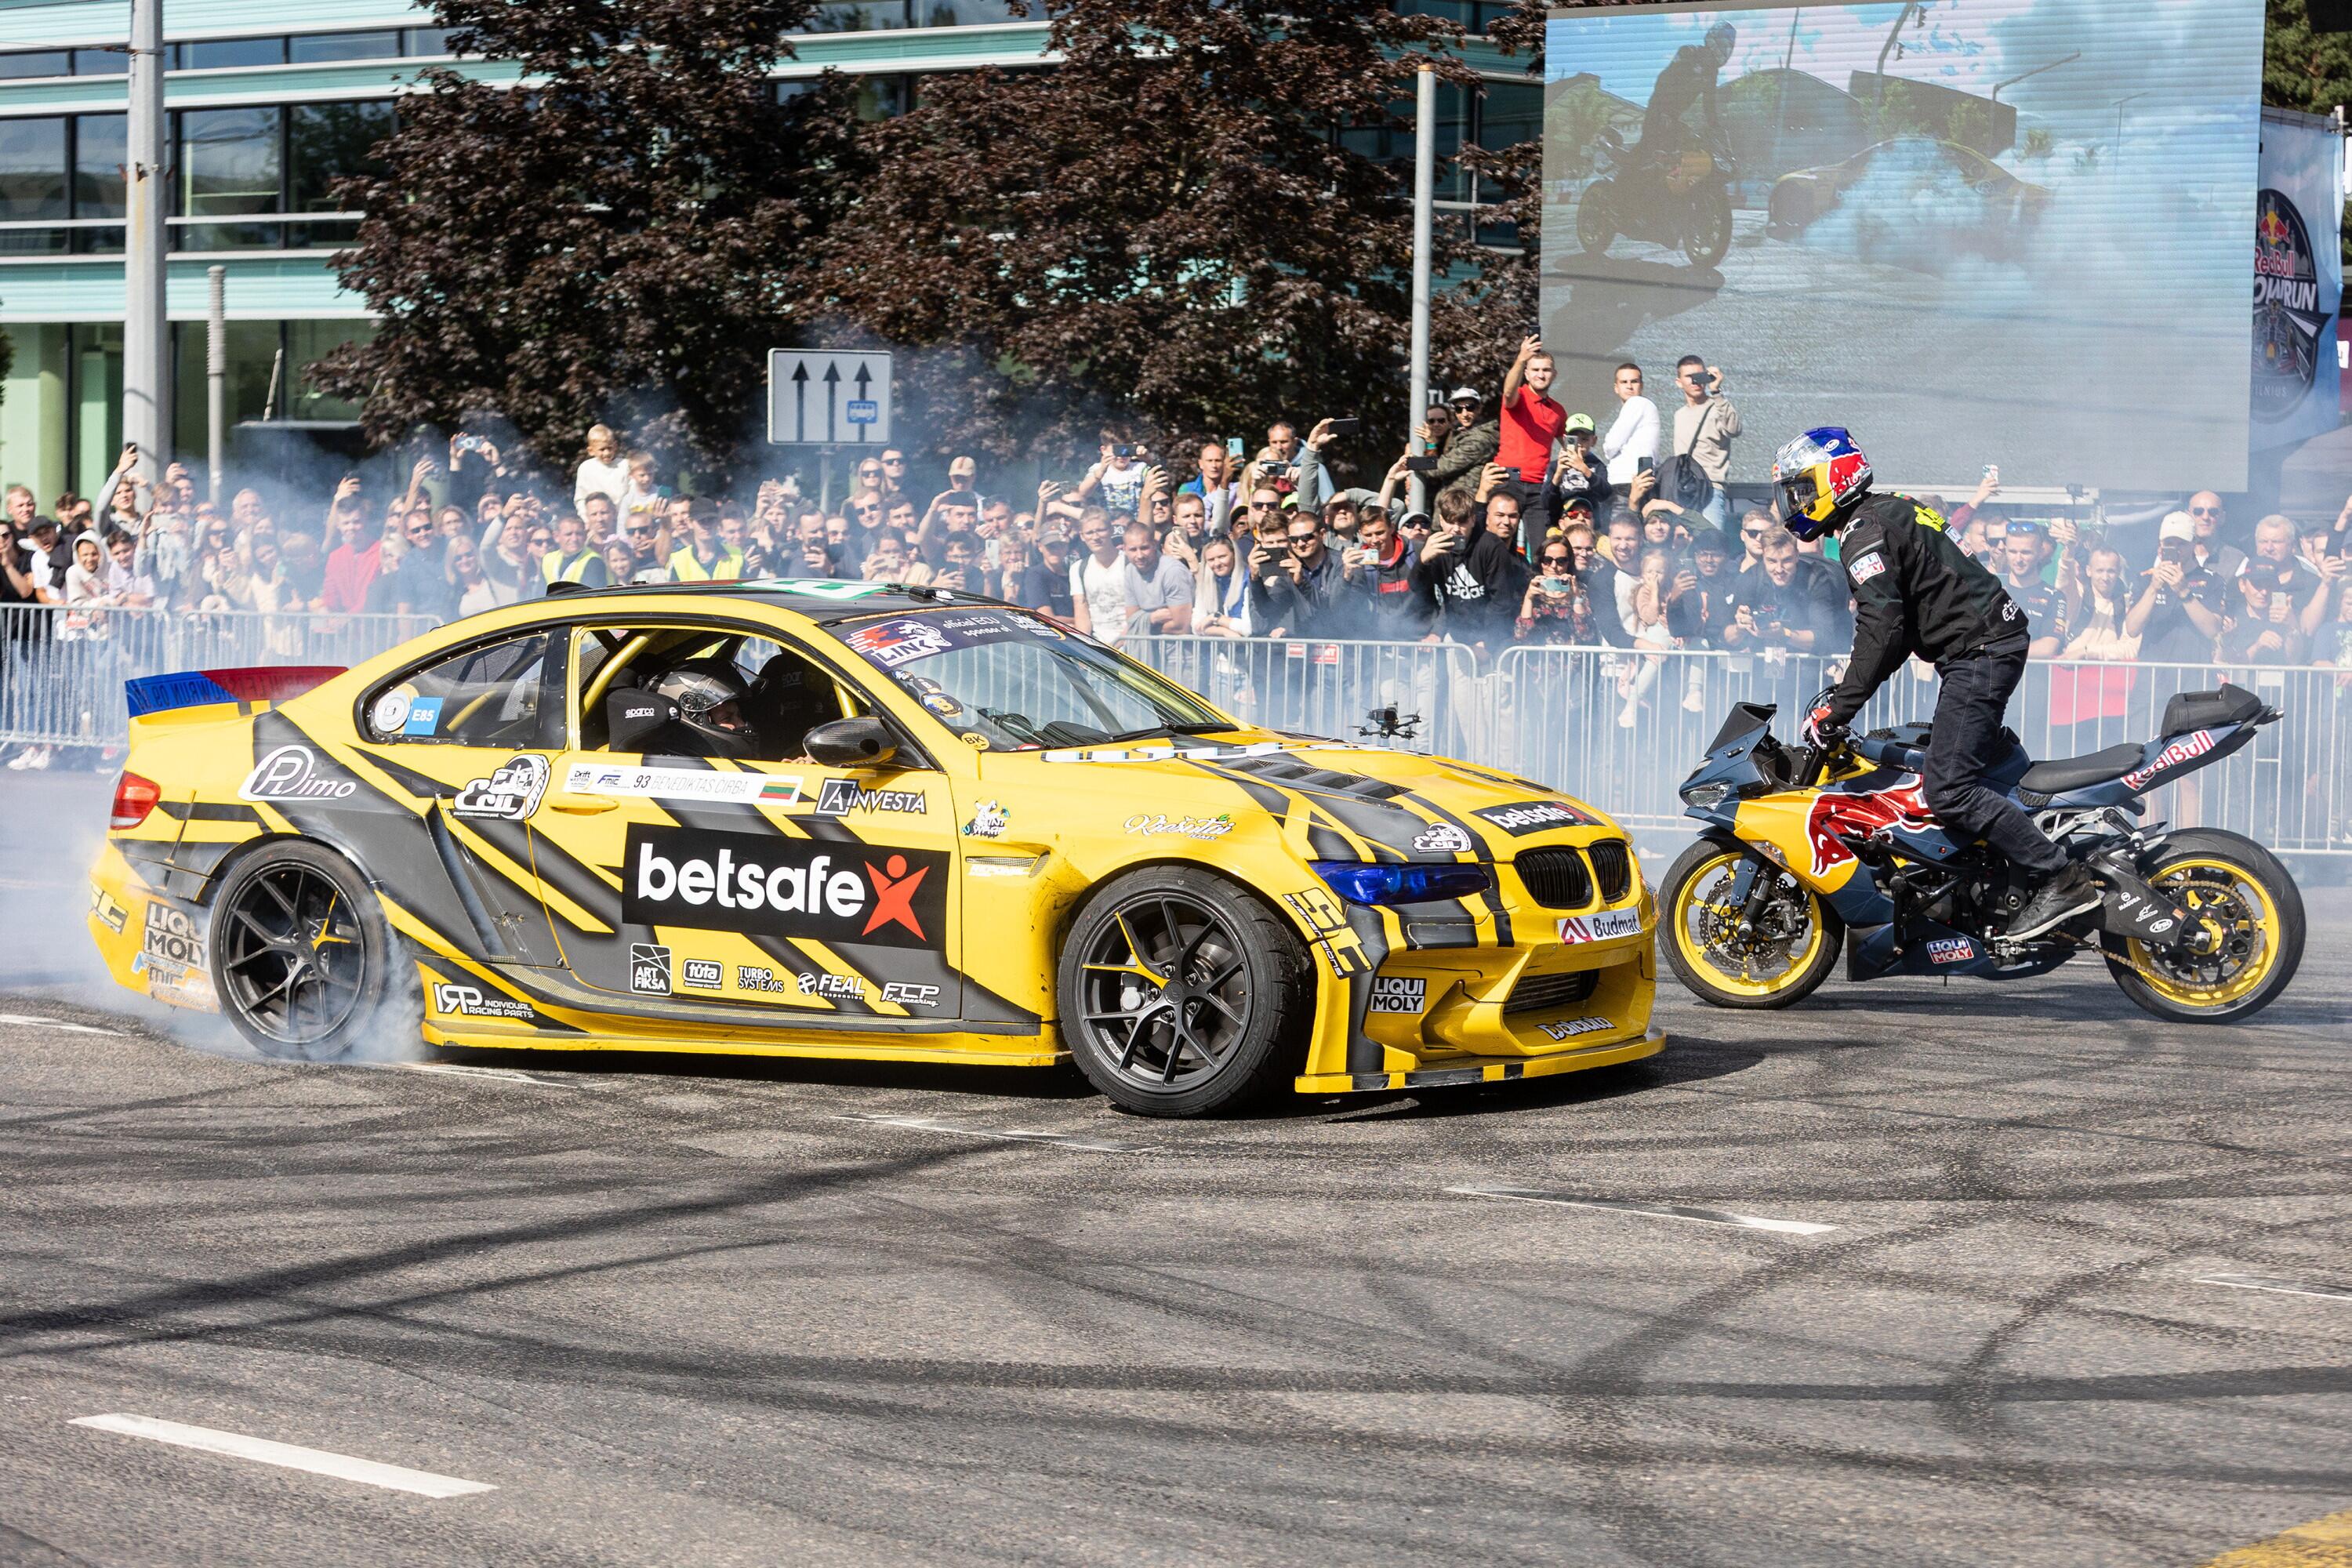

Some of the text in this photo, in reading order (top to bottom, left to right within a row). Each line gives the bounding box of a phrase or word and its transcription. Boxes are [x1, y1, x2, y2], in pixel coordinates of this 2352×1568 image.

[2253, 275, 2317, 311] OWRUN
[977, 616, 1000, 626] ECU
[963, 626, 998, 638] sponsor
[411, 709, 435, 722] E85
[625, 707, 655, 719] sparco
[964, 734, 985, 746] BK
[2120, 730, 2216, 791] Red Bull
[633, 775, 652, 789] 93
[652, 775, 713, 793] BENEDIKTAS
[1482, 805, 1575, 830] betsafe
[637, 842, 866, 917] betsafe
[149, 902, 205, 941] LIQU
[1592, 913, 1641, 938] Budmat
[1929, 938, 1968, 953] LIQUI
[1933, 948, 1970, 962] MOLY
[635, 965, 659, 978] ART
[738, 966, 773, 981] TURBO
[634, 977, 666, 991] FIKSA
[738, 978, 785, 993] SYSTEMS
[818, 974, 866, 994] FEAL
[881, 982, 941, 1001] FCP
[1374, 978, 1425, 996] LIQUI
[485, 1000, 532, 1011] INDIVIDUAL
[885, 994, 940, 1007] Engineering
[1372, 995, 1424, 1012] MOLY
[468, 1006, 535, 1018] RACING PARTS
